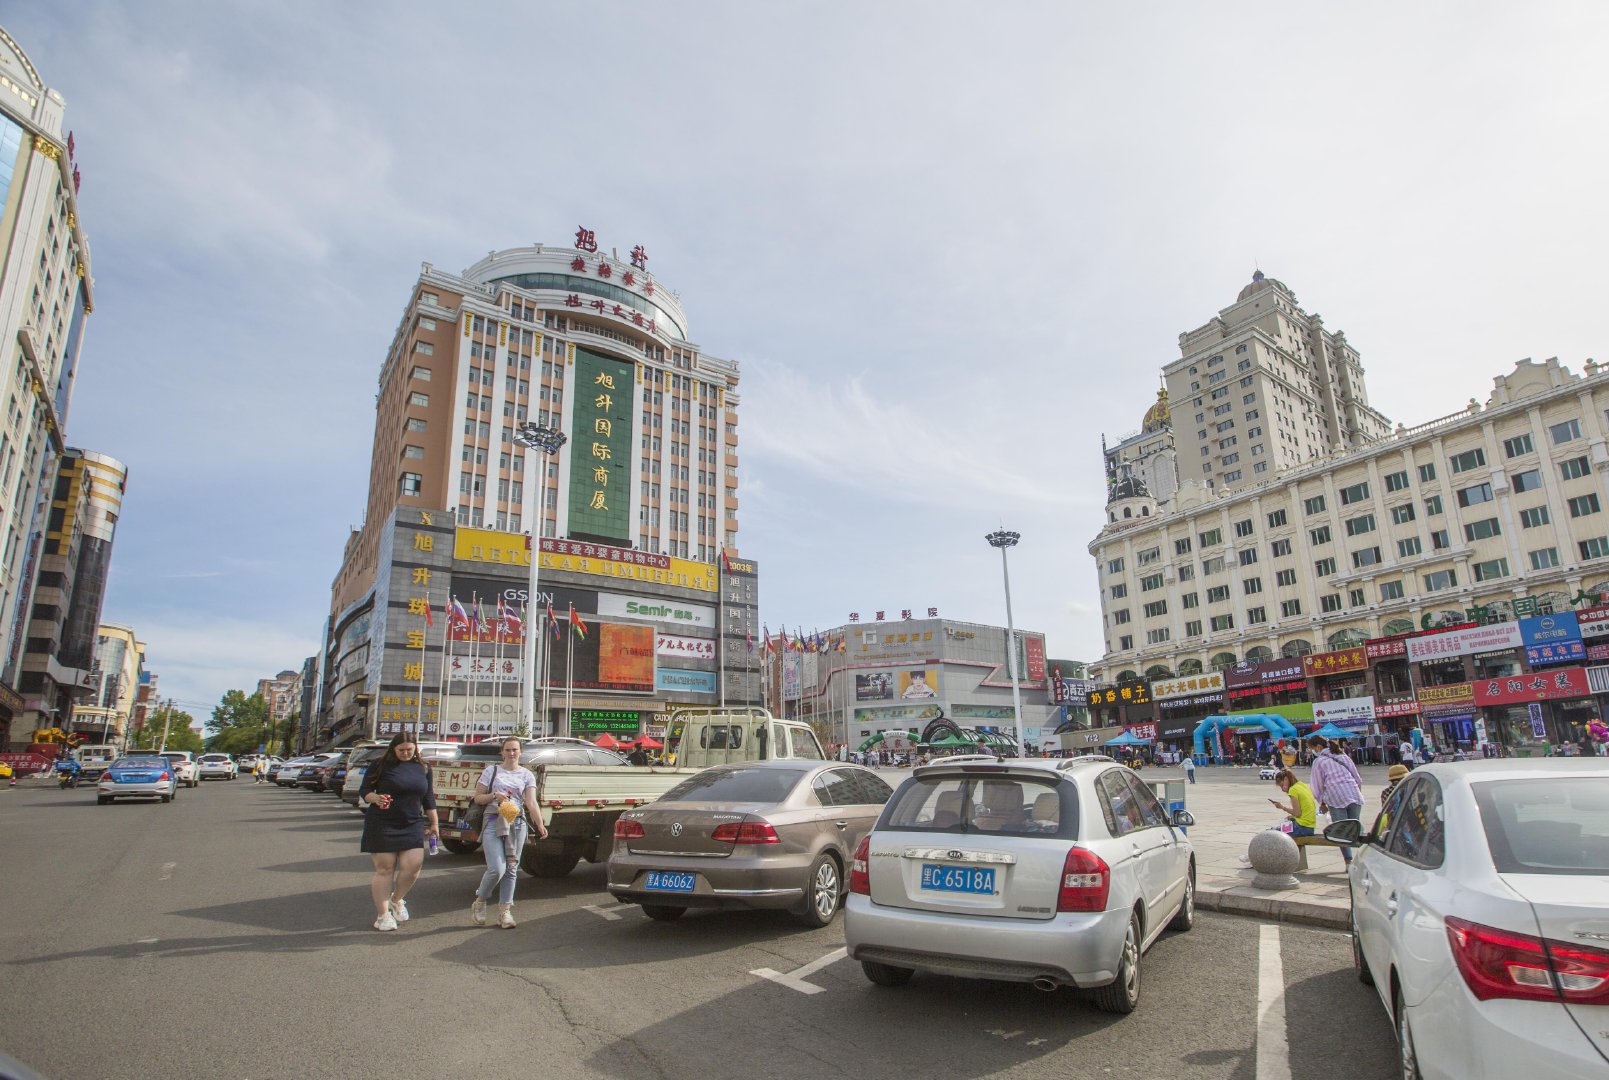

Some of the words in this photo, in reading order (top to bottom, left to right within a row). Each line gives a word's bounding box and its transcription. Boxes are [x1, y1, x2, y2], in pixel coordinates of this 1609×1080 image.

[589, 371, 616, 511] 旭升国际商厦
[602, 561, 703, 588] ИМПЕРИЯ
[403, 532, 434, 682] 旭升珠宝城
[626, 601, 673, 617] Semir
[849, 607, 938, 623] 华夏影院
[1091, 685, 1146, 705] 奶香铺子
[1486, 672, 1572, 696] 名阳女装
[949, 851, 962, 859] KIA
